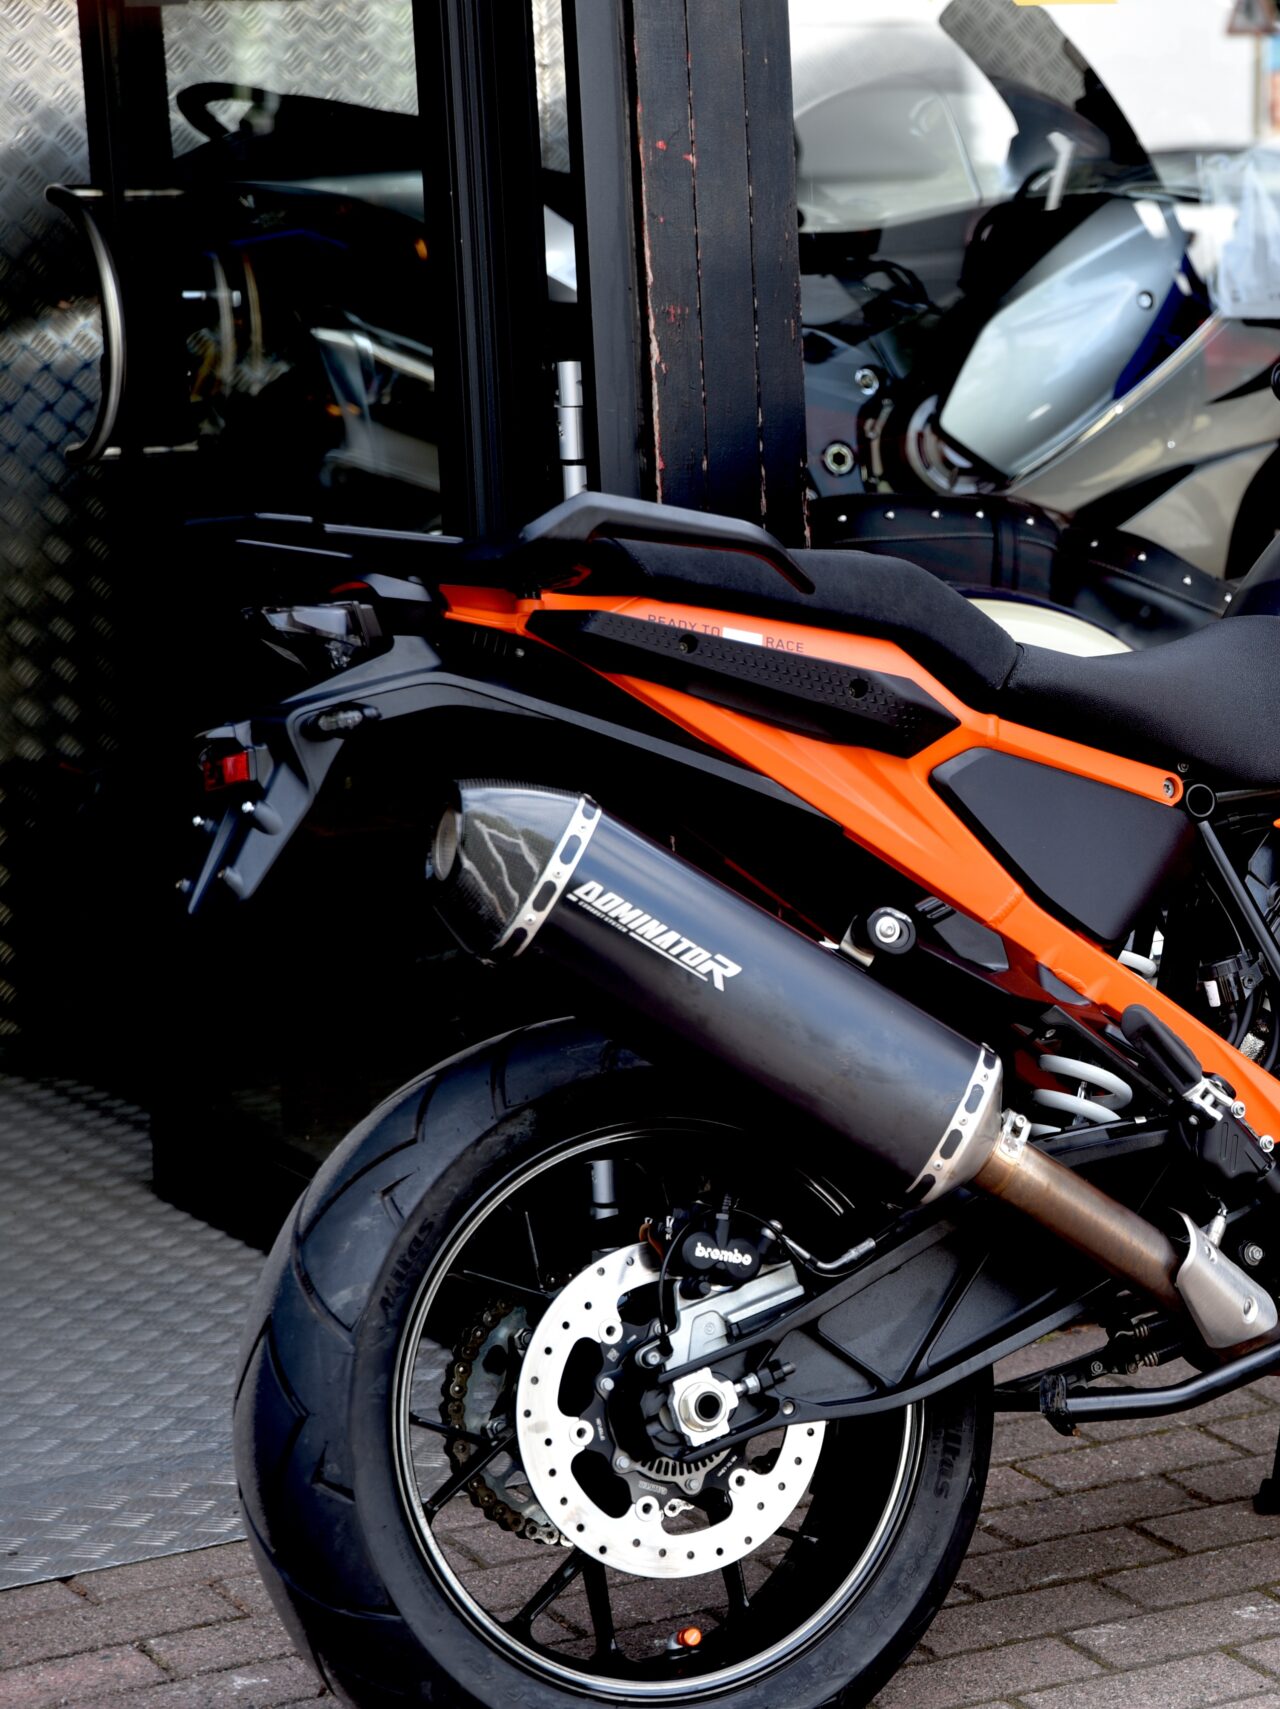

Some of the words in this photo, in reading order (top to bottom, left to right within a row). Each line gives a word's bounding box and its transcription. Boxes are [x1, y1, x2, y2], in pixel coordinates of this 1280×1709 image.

[766, 637, 804, 653] RACE
[572, 880, 743, 992] DOMINATOR
[694, 1241, 752, 1266] brembo
